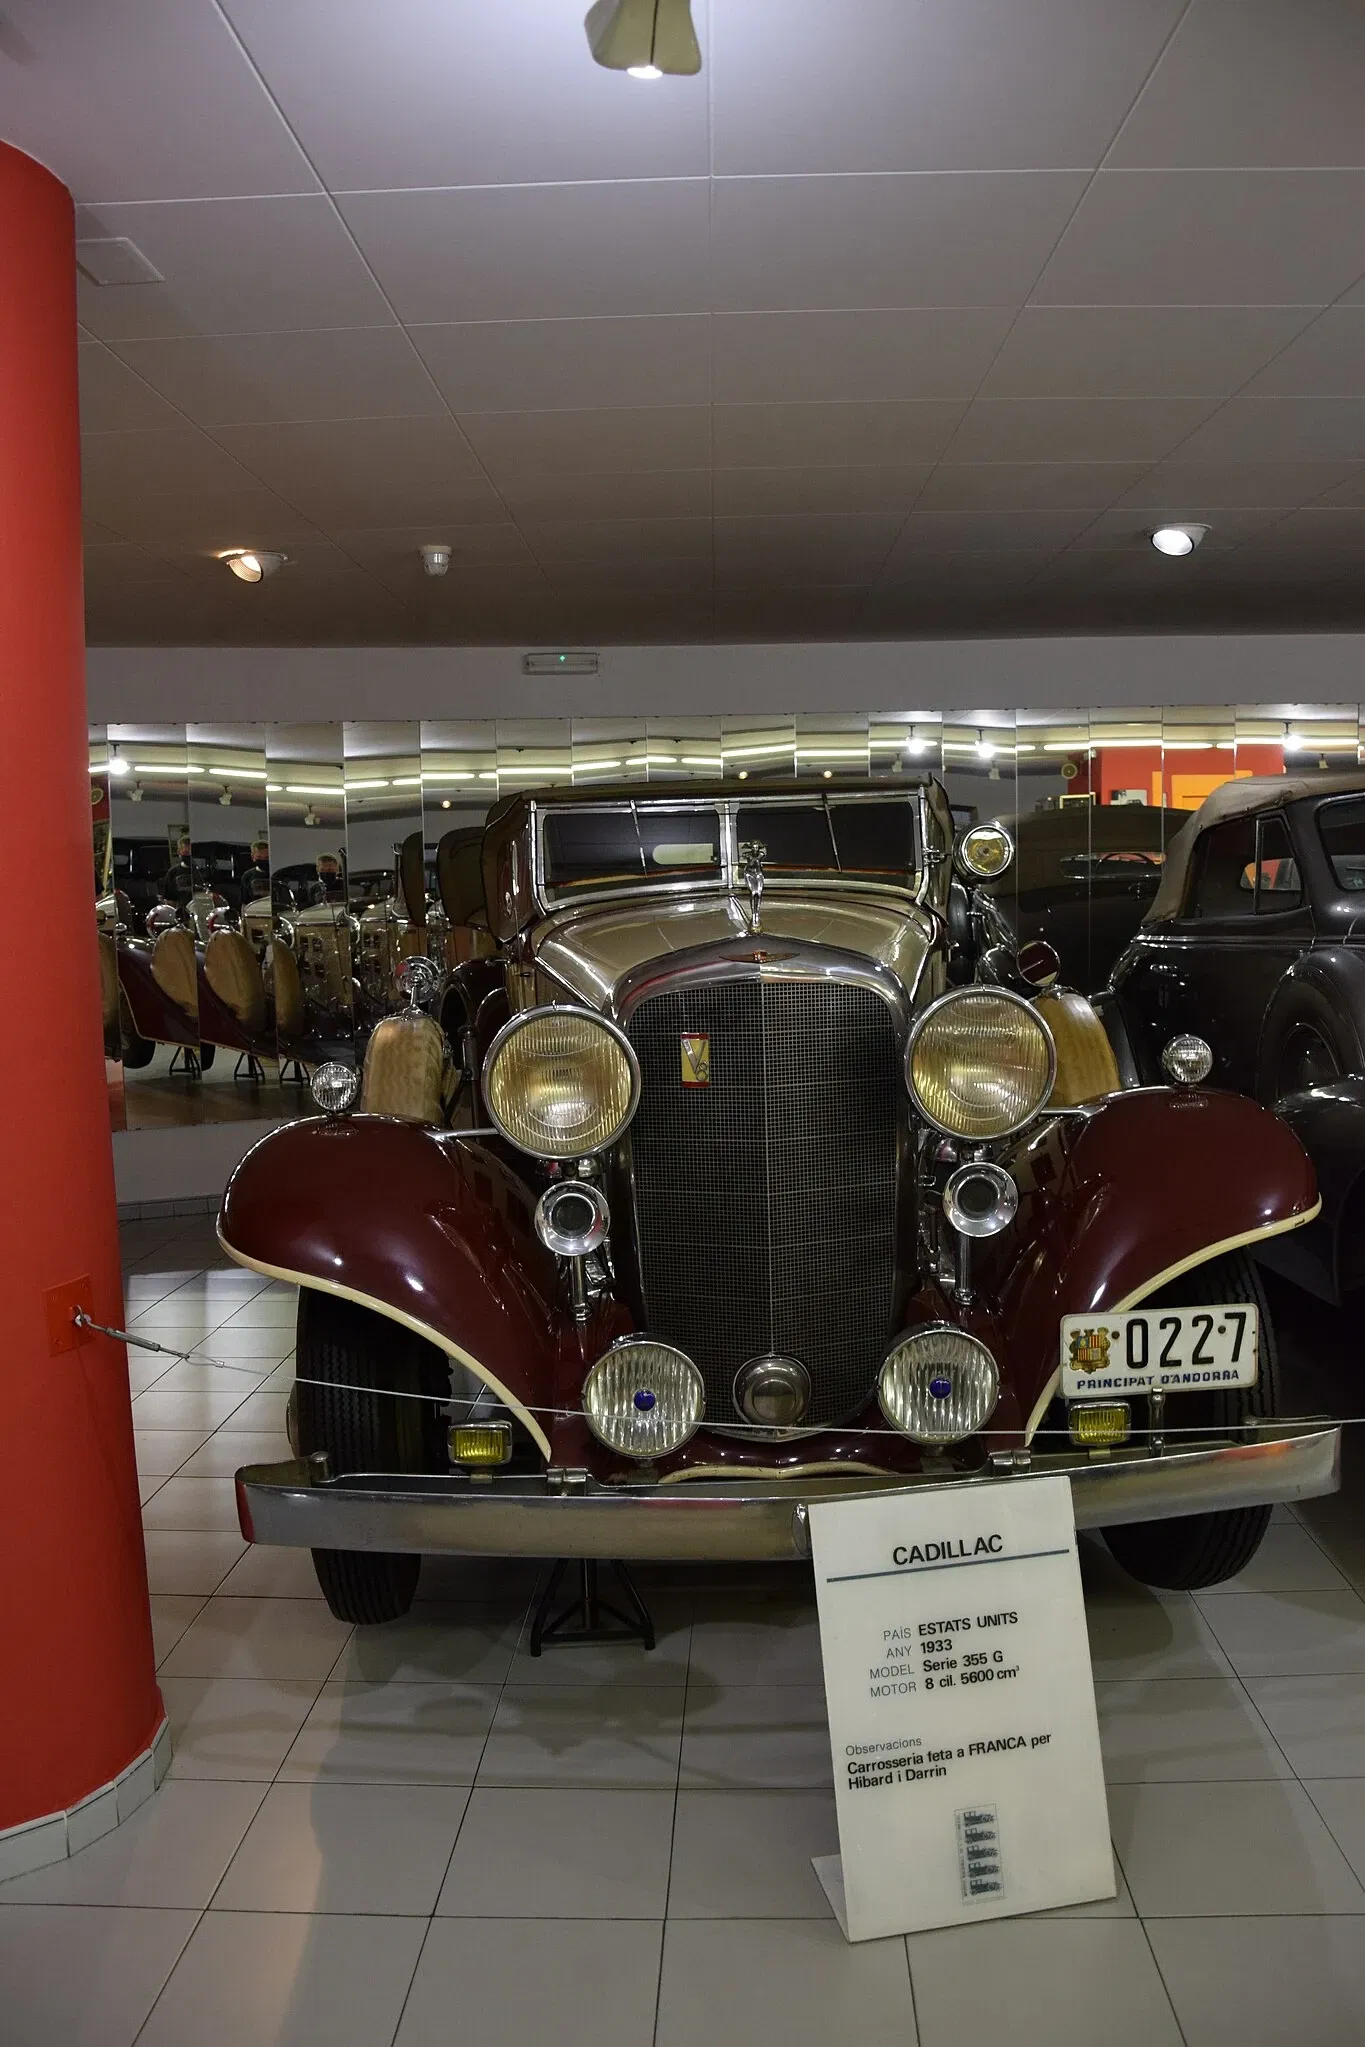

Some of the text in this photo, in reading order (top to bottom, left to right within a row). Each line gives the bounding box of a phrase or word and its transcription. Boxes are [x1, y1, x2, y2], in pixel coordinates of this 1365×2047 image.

[1077, 1369, 1239, 1390] PRINCIPAT D'ANDORRA
[893, 1534, 1004, 1566] CADILLAC
[918, 1617, 971, 1636] ESTATS
[977, 1611, 1018, 1628] UNITS
[886, 1638, 953, 1659] ANY 1933
[869, 1650, 1004, 1679] MODEL Serie 355 G
[870, 1682, 917, 1698] MOTOR
[925, 1677, 935, 1690] 8
[939, 1674, 957, 1688] cil.
[960, 1668, 994, 1685] 5600
[845, 1736, 922, 1756] Observacions
[847, 1734, 1052, 1775] Carrosseria feta a FRANCA per
[848, 1765, 947, 1790] Hibard i Darrin
